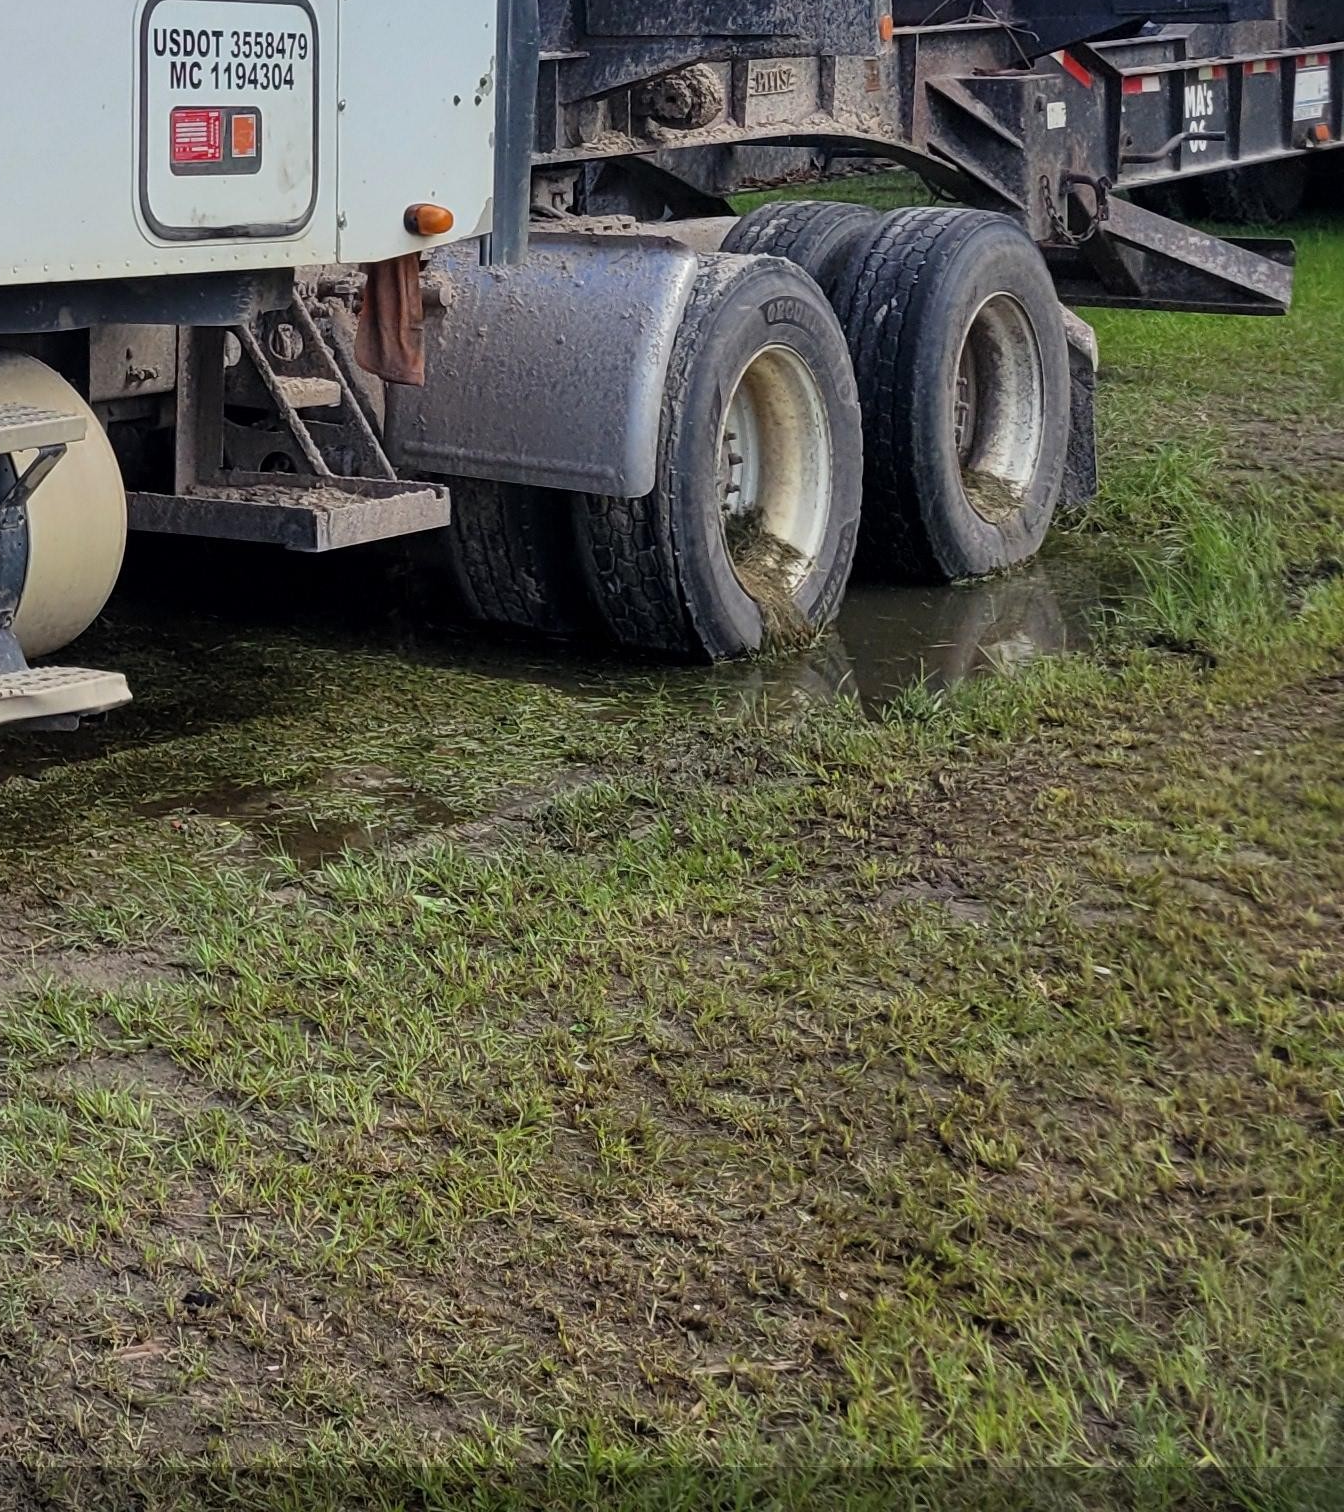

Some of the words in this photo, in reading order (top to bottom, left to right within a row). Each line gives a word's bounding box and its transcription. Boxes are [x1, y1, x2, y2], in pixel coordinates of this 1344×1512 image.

[153, 28, 224, 58] USDOT
[230, 31, 308, 60] 3558479
[169, 62, 203, 90] MC
[210, 62, 295, 91] 1194304
